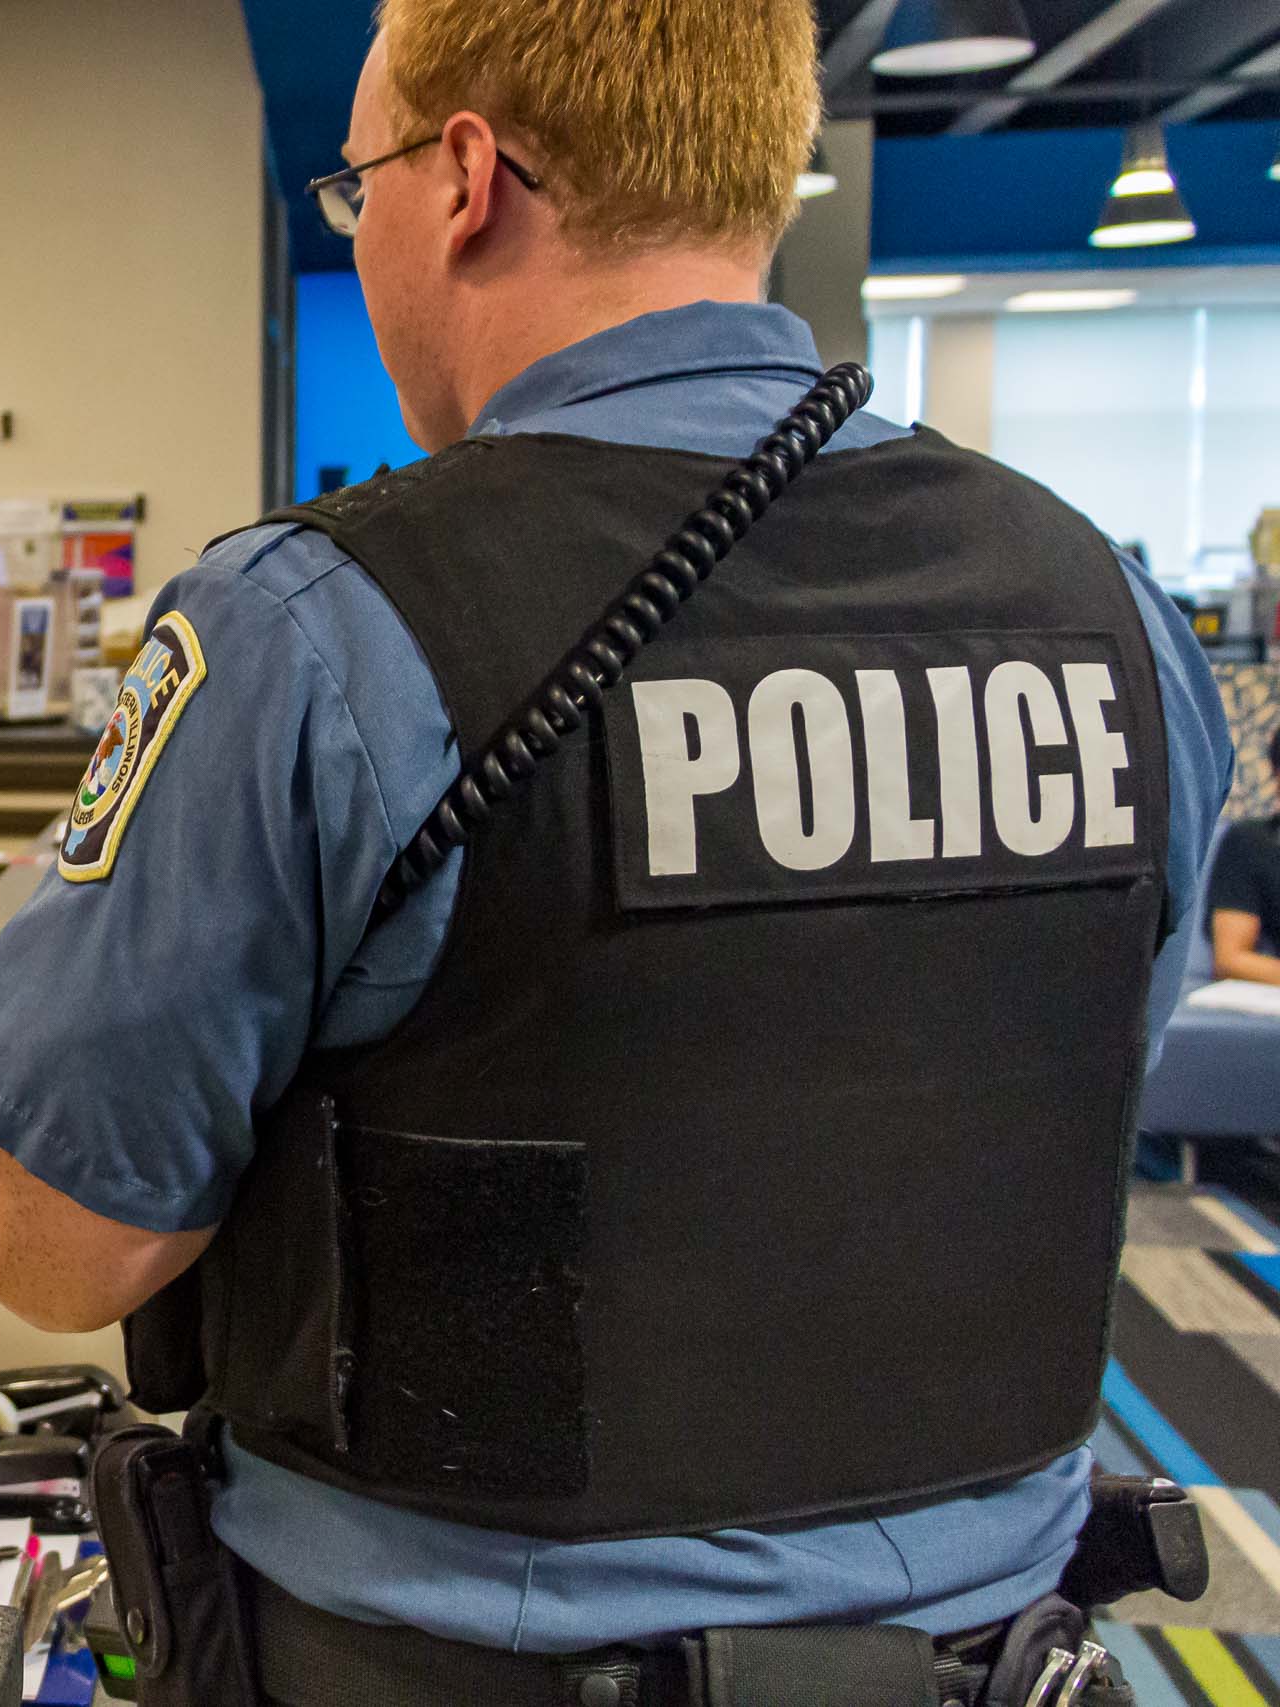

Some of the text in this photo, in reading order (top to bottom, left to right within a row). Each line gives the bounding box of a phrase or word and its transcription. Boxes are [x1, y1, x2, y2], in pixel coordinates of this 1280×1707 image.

[127, 641, 180, 709] LICE
[111, 718, 138, 793] ILLINOIS
[631, 661, 1134, 876] POLICE
